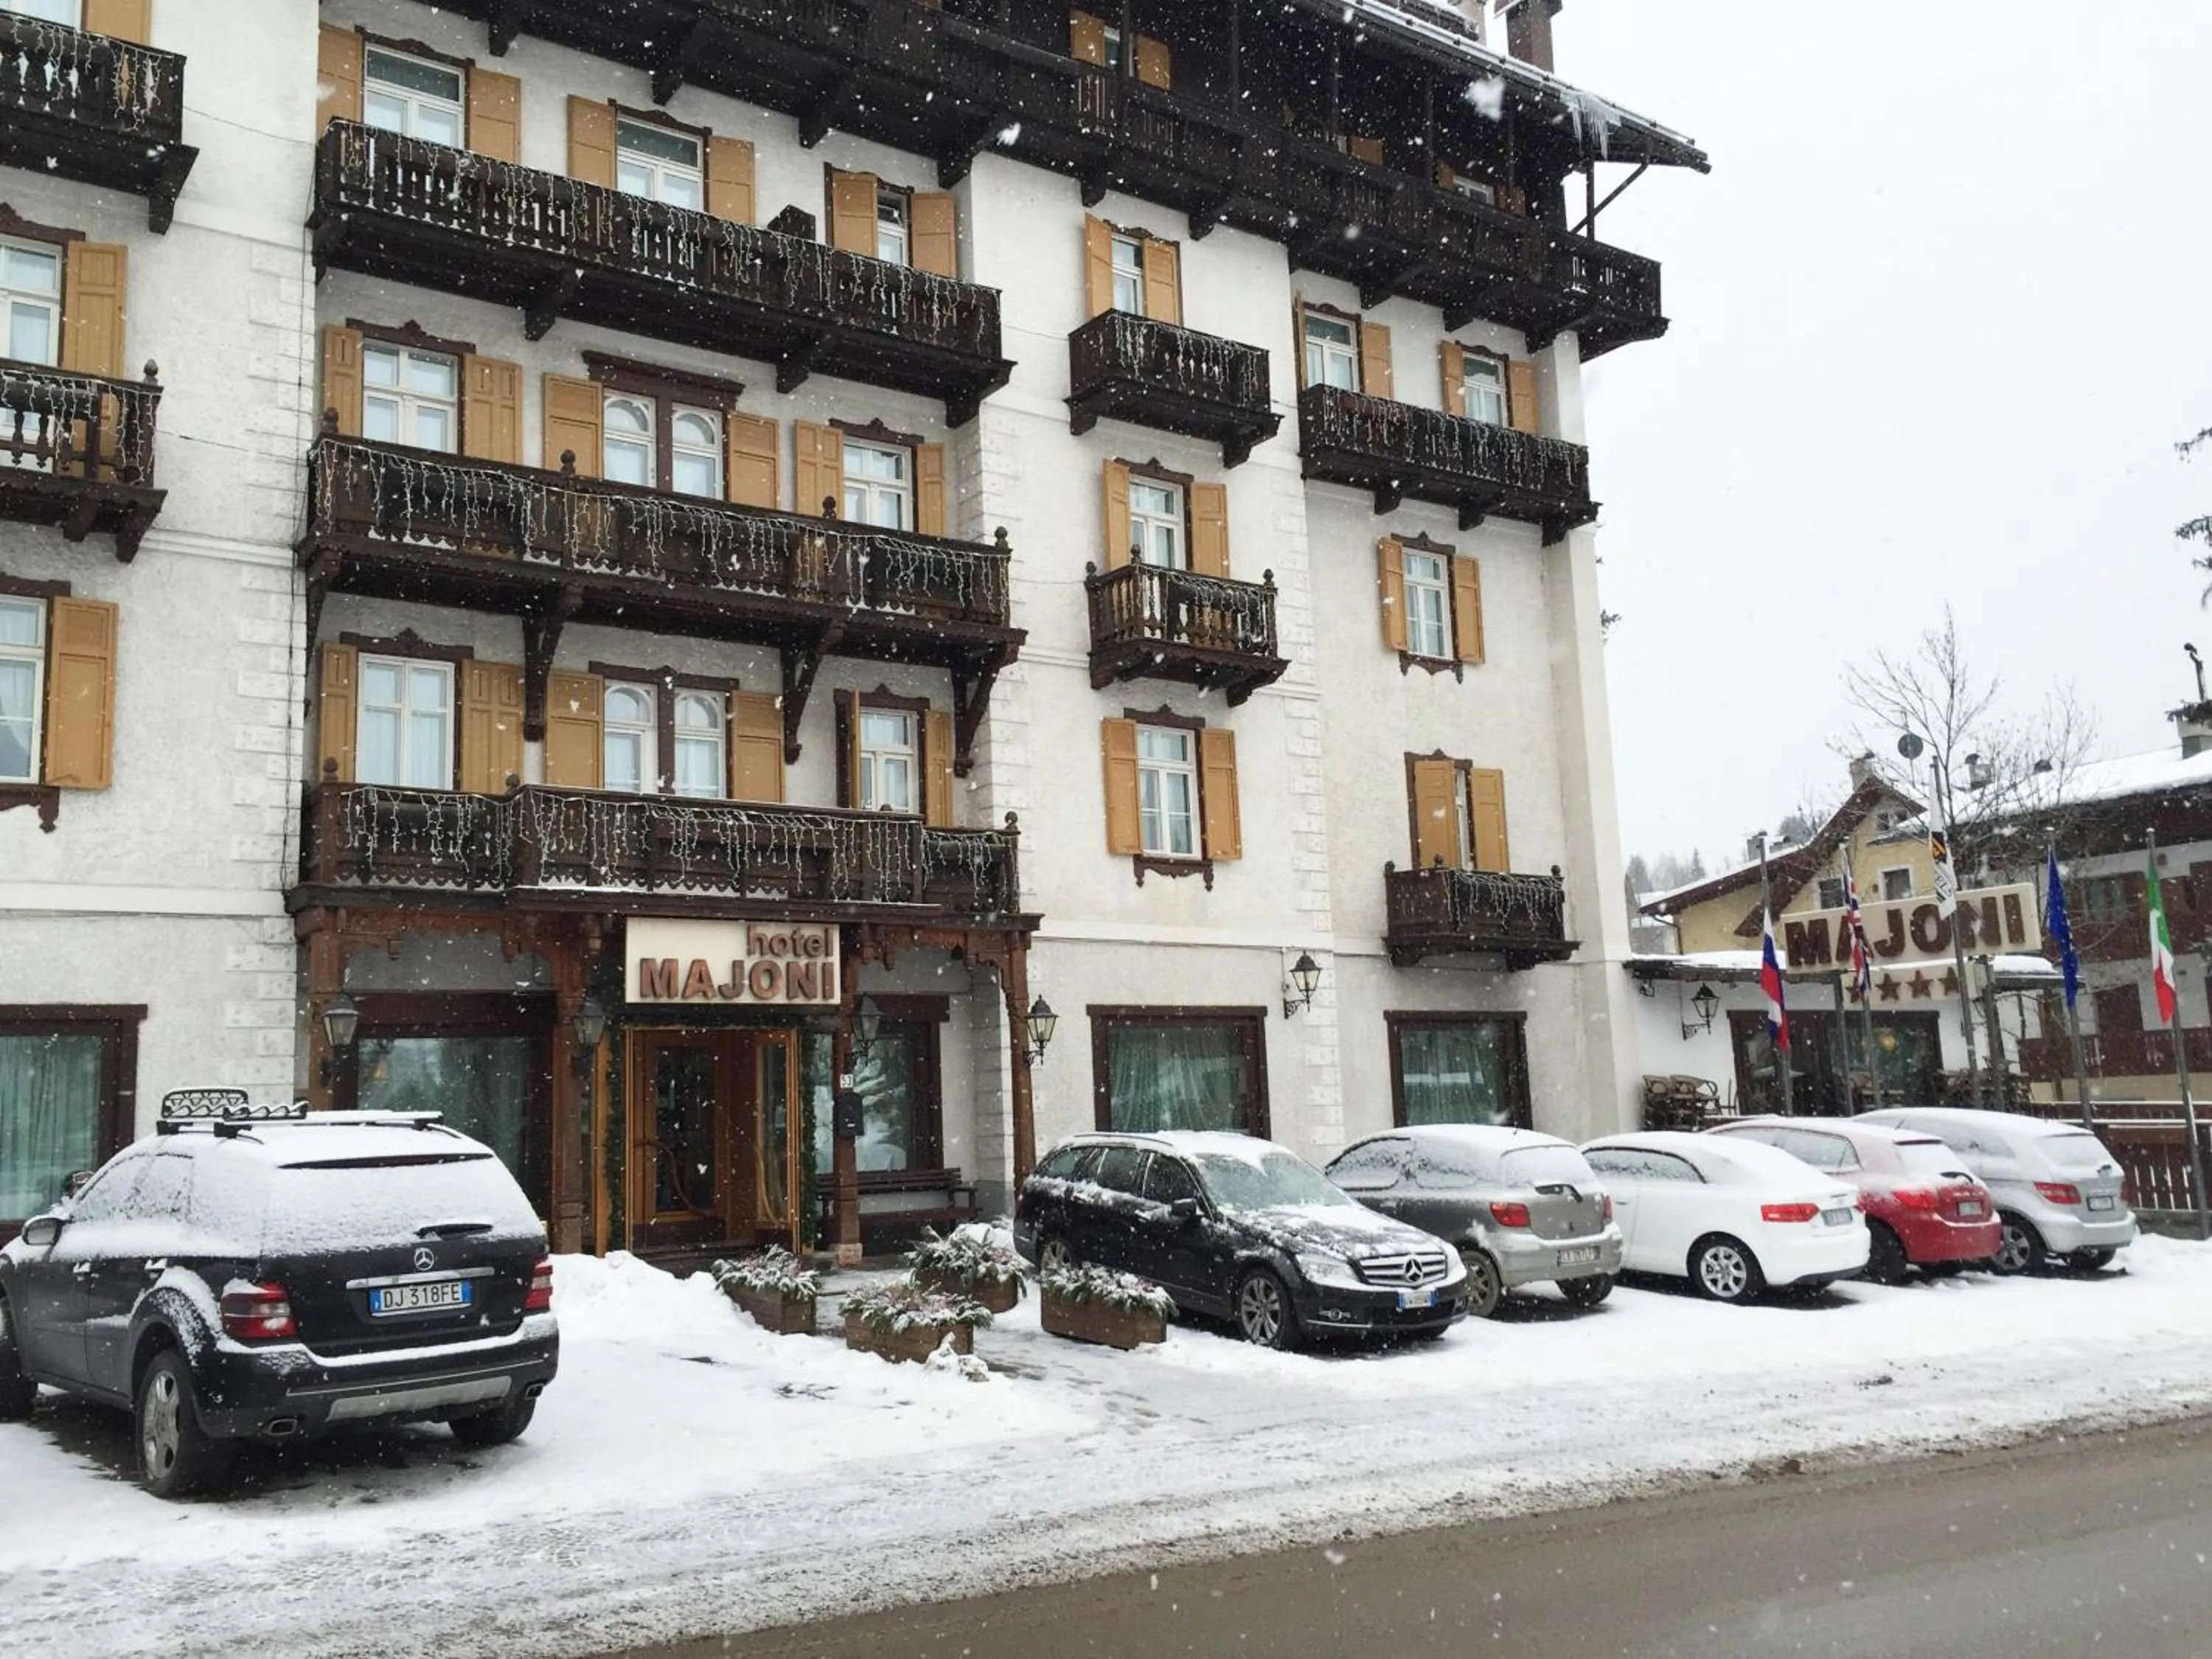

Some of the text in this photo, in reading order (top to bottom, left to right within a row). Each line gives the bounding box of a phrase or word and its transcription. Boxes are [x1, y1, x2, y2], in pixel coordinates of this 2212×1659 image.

[746, 924, 834, 958] hotel
[639, 958, 835, 1001] MAJONI
[384, 1284, 460, 1309] DJ 318FE
